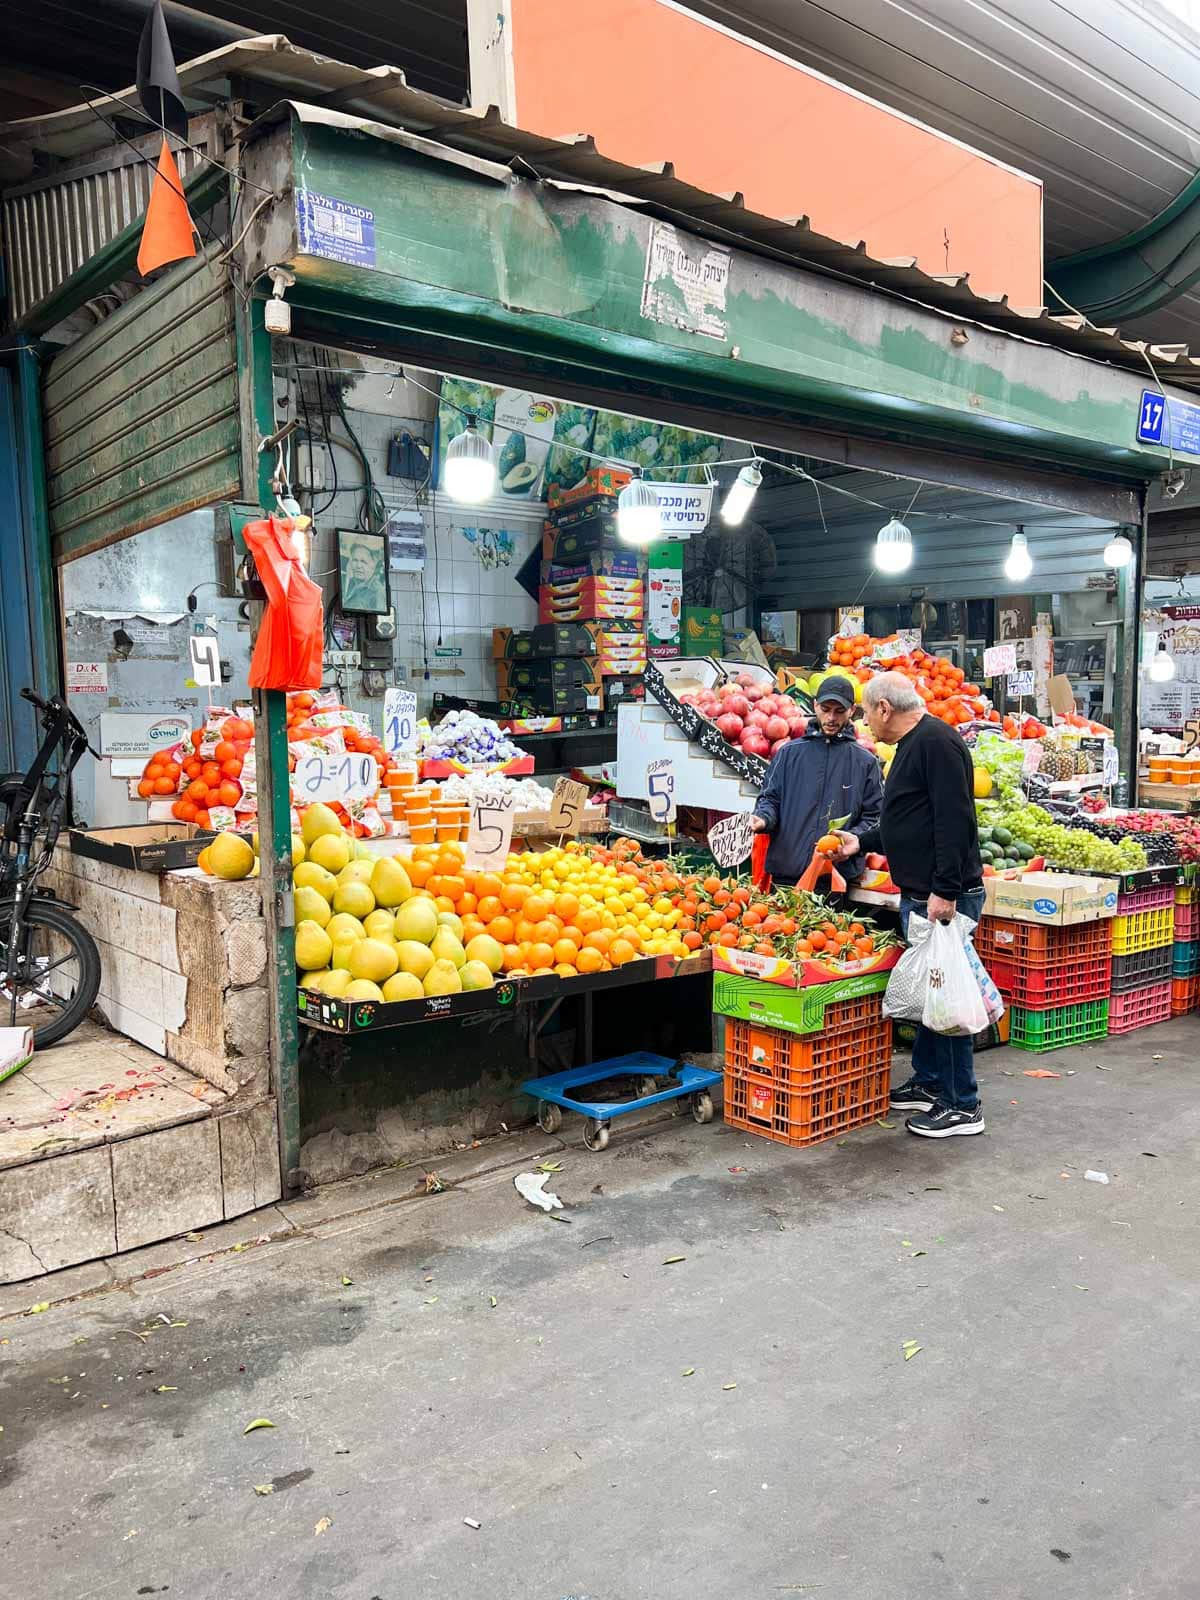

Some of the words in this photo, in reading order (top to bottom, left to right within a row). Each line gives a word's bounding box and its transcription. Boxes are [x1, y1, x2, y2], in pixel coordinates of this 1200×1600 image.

[336, 202, 374, 220] מסגרית
[703, 264, 726, 282] יצחק
[1142, 402, 1163, 432] 17
[657, 497, 682, 507] מכבד
[683, 498, 702, 510] כאן
[674, 512, 706, 521] כרטיסי
[193, 639, 215, 682] 4
[150, 727, 179, 739] Carmel
[386, 716, 411, 751] 10
[1184, 719, 1200, 747] 5
[555, 803, 578, 829] 5
[474, 807, 505, 854] 5
